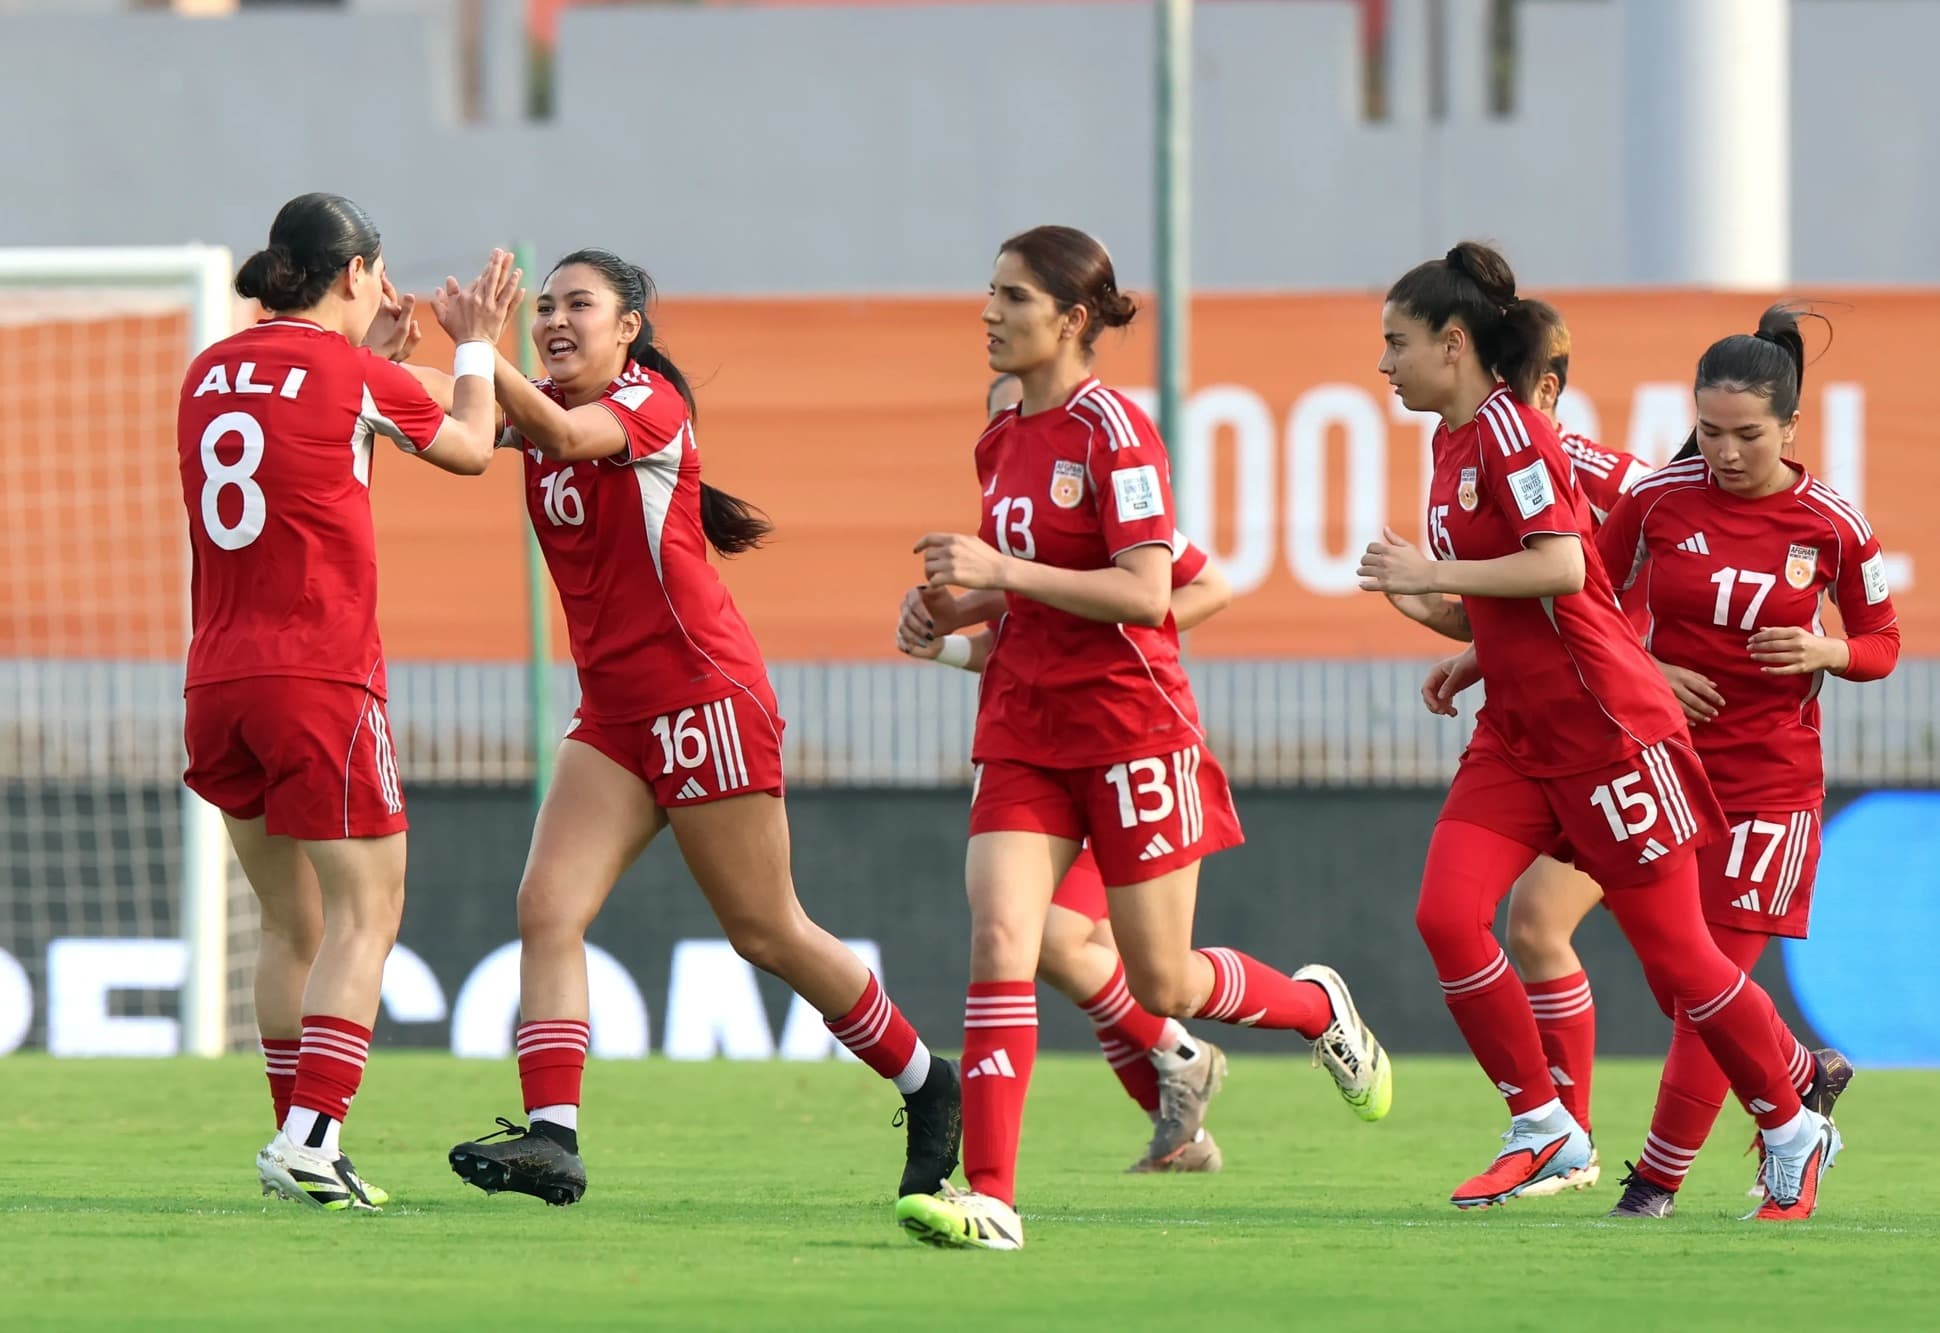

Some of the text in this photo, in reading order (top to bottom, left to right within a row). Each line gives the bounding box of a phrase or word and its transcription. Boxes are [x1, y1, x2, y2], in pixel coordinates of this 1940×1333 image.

[193, 362, 308, 399] ALI
[200, 411, 267, 551] 8
[540, 466, 585, 526] 16
[991, 496, 1036, 560] 13
[1430, 504, 1458, 560] 15
[1790, 545, 1816, 556] AFGHAN
[1710, 566, 1777, 631] 17
[651, 707, 708, 774] 16
[1105, 756, 1175, 829] 13
[1590, 770, 1658, 842] 15
[1724, 819, 1787, 883] 17
